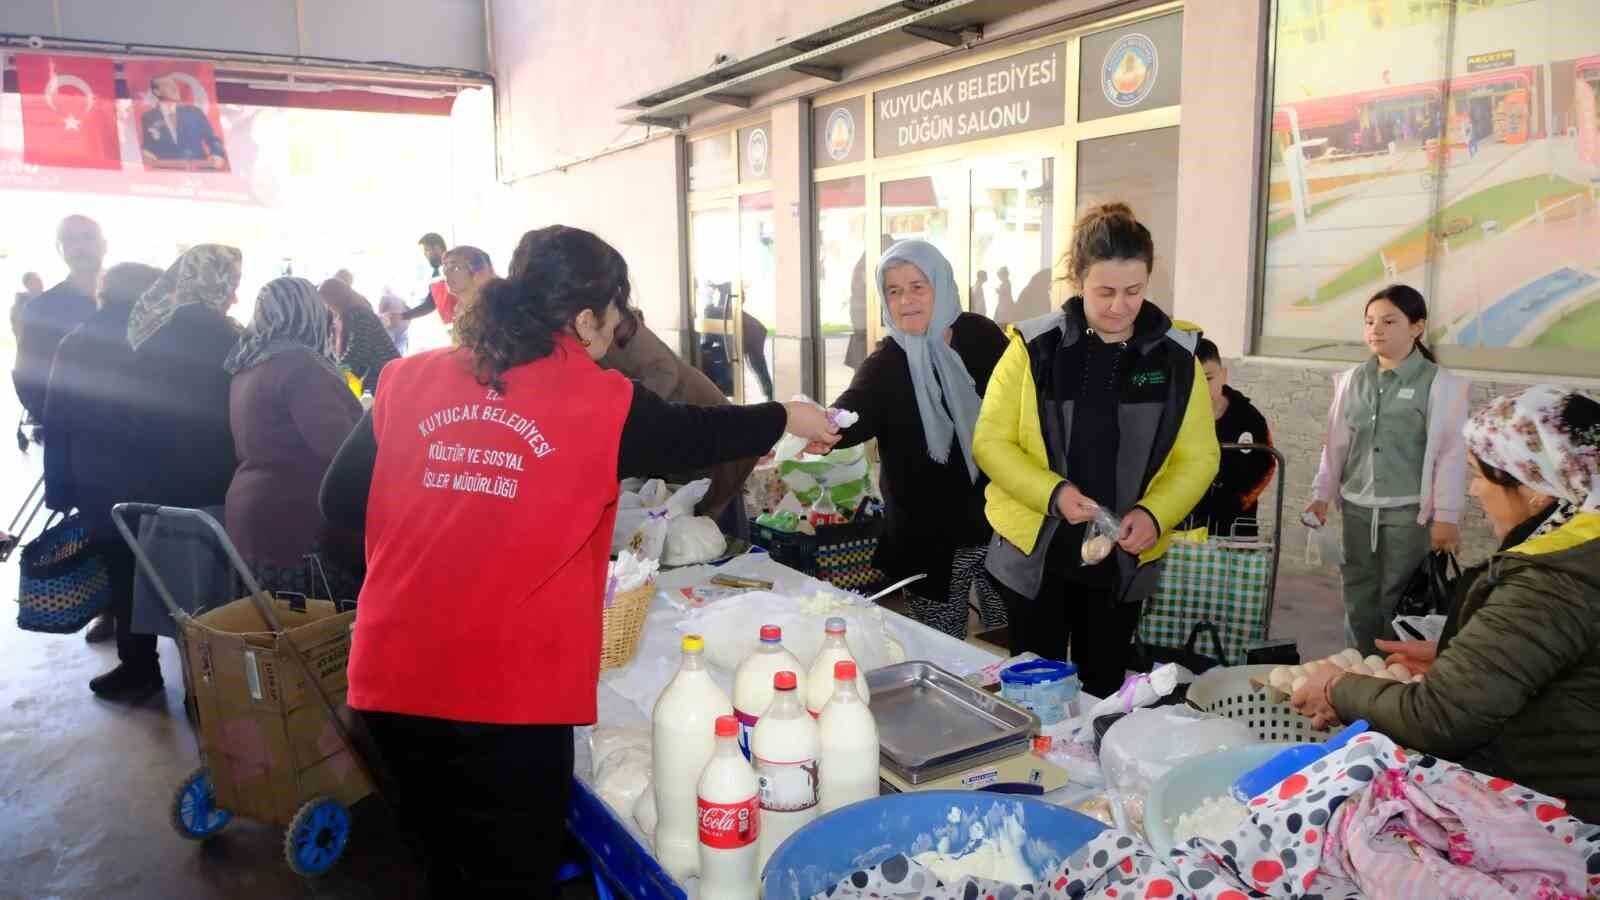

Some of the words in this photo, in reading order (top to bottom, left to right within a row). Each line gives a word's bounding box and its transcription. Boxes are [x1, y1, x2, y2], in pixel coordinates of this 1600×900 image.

[880, 84, 954, 120] KUYUCAK
[958, 52, 1057, 102] BELEDİYESİ
[899, 114, 953, 146] DÜĞÜN
[957, 101, 1030, 136] SALONU
[418, 404, 480, 437] KUYUCAK
[481, 406, 556, 458] BELEDİYESİ
[428, 441, 466, 463] KÜLTÜR
[467, 447, 482, 464] VE
[482, 450, 525, 471] SOSYAL
[452, 472, 519, 499] MÜDÜRLÜĞÜ
